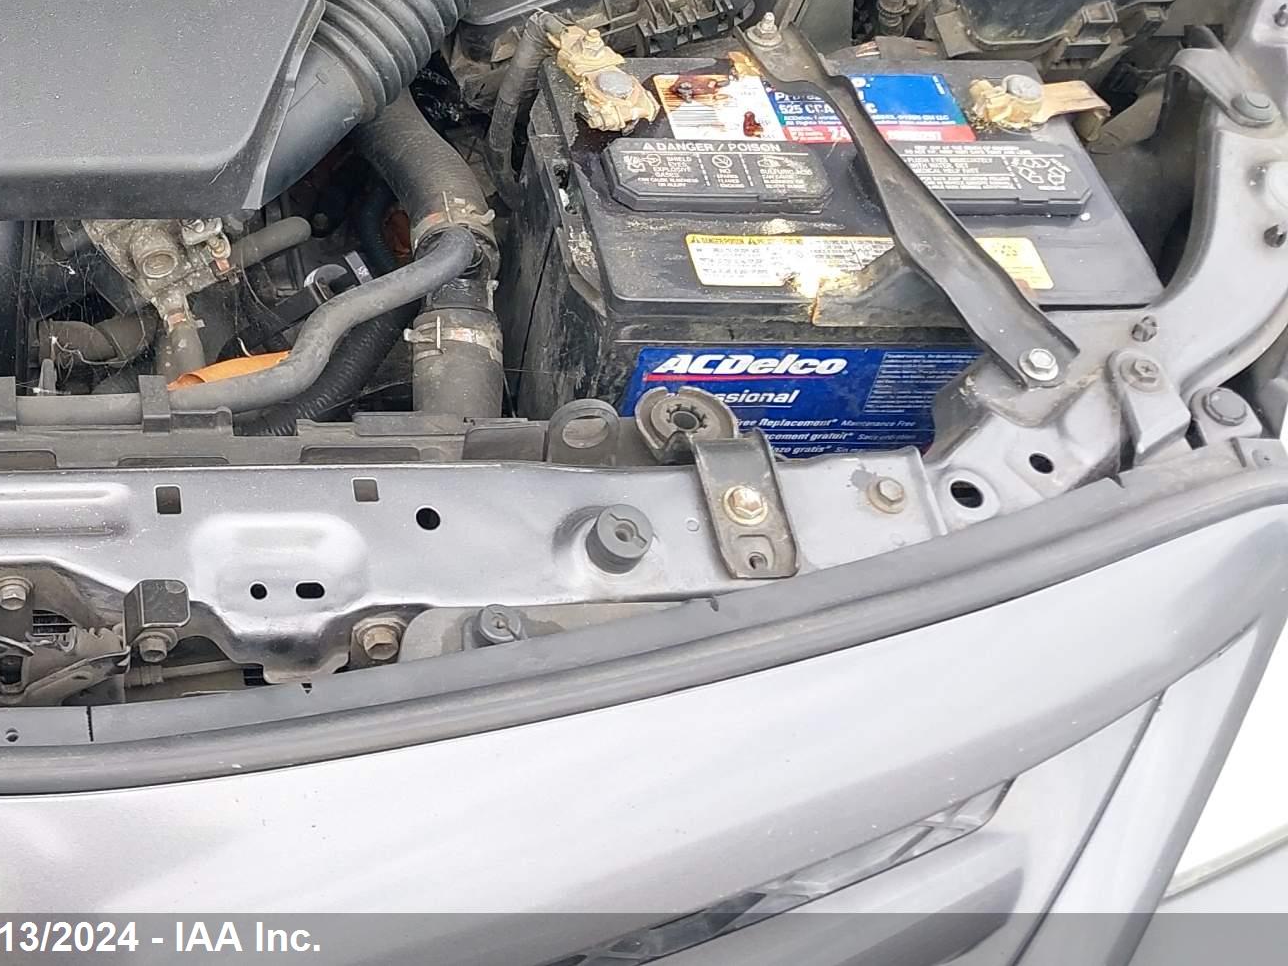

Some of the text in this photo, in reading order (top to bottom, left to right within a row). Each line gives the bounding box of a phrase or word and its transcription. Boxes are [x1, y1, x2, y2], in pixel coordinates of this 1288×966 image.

[778, 104, 803, 114] 525
[655, 143, 716, 151] DANGER
[728, 143, 781, 152] POISON
[652, 353, 848, 375] ACDelco
[713, 389, 801, 404] ssional
